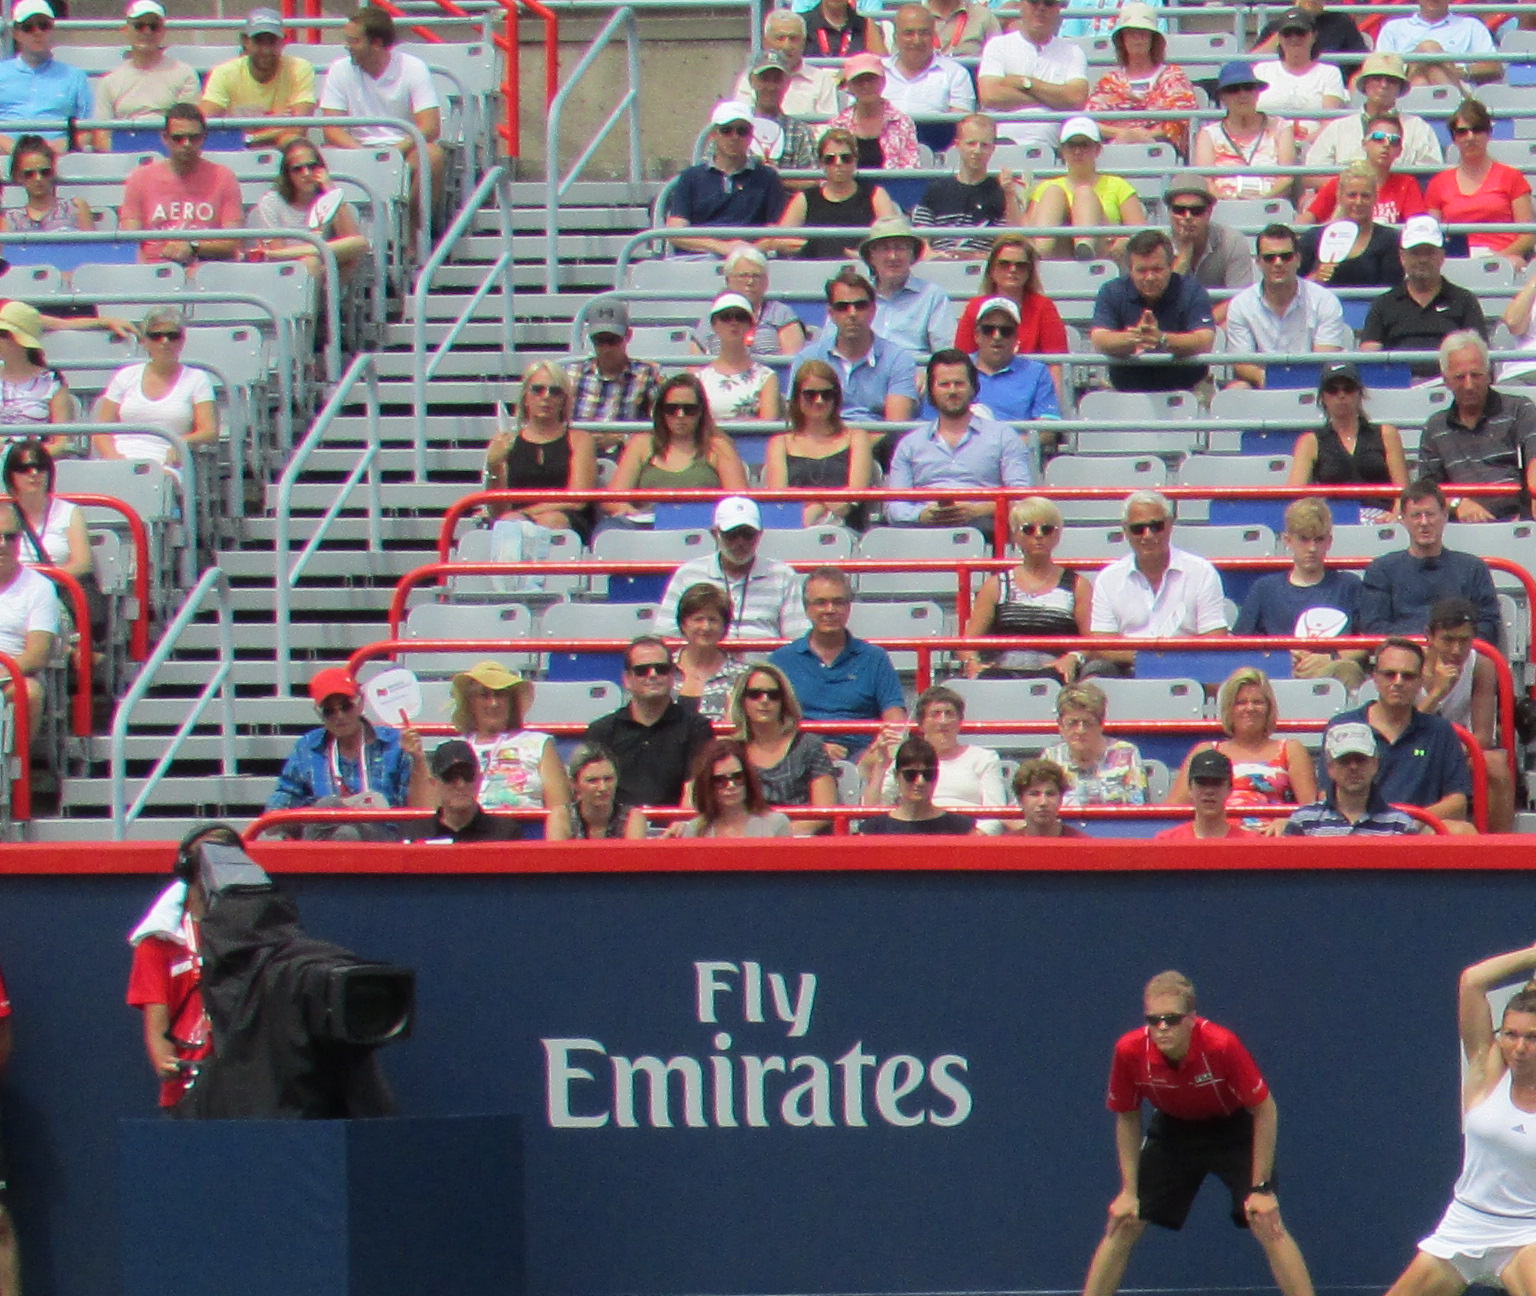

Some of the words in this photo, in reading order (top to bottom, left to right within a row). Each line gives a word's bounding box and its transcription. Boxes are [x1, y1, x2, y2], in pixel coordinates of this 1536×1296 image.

[152, 202, 214, 221] AERO
[696, 962, 817, 1037] Fly
[542, 1033, 972, 1129] Emirates
